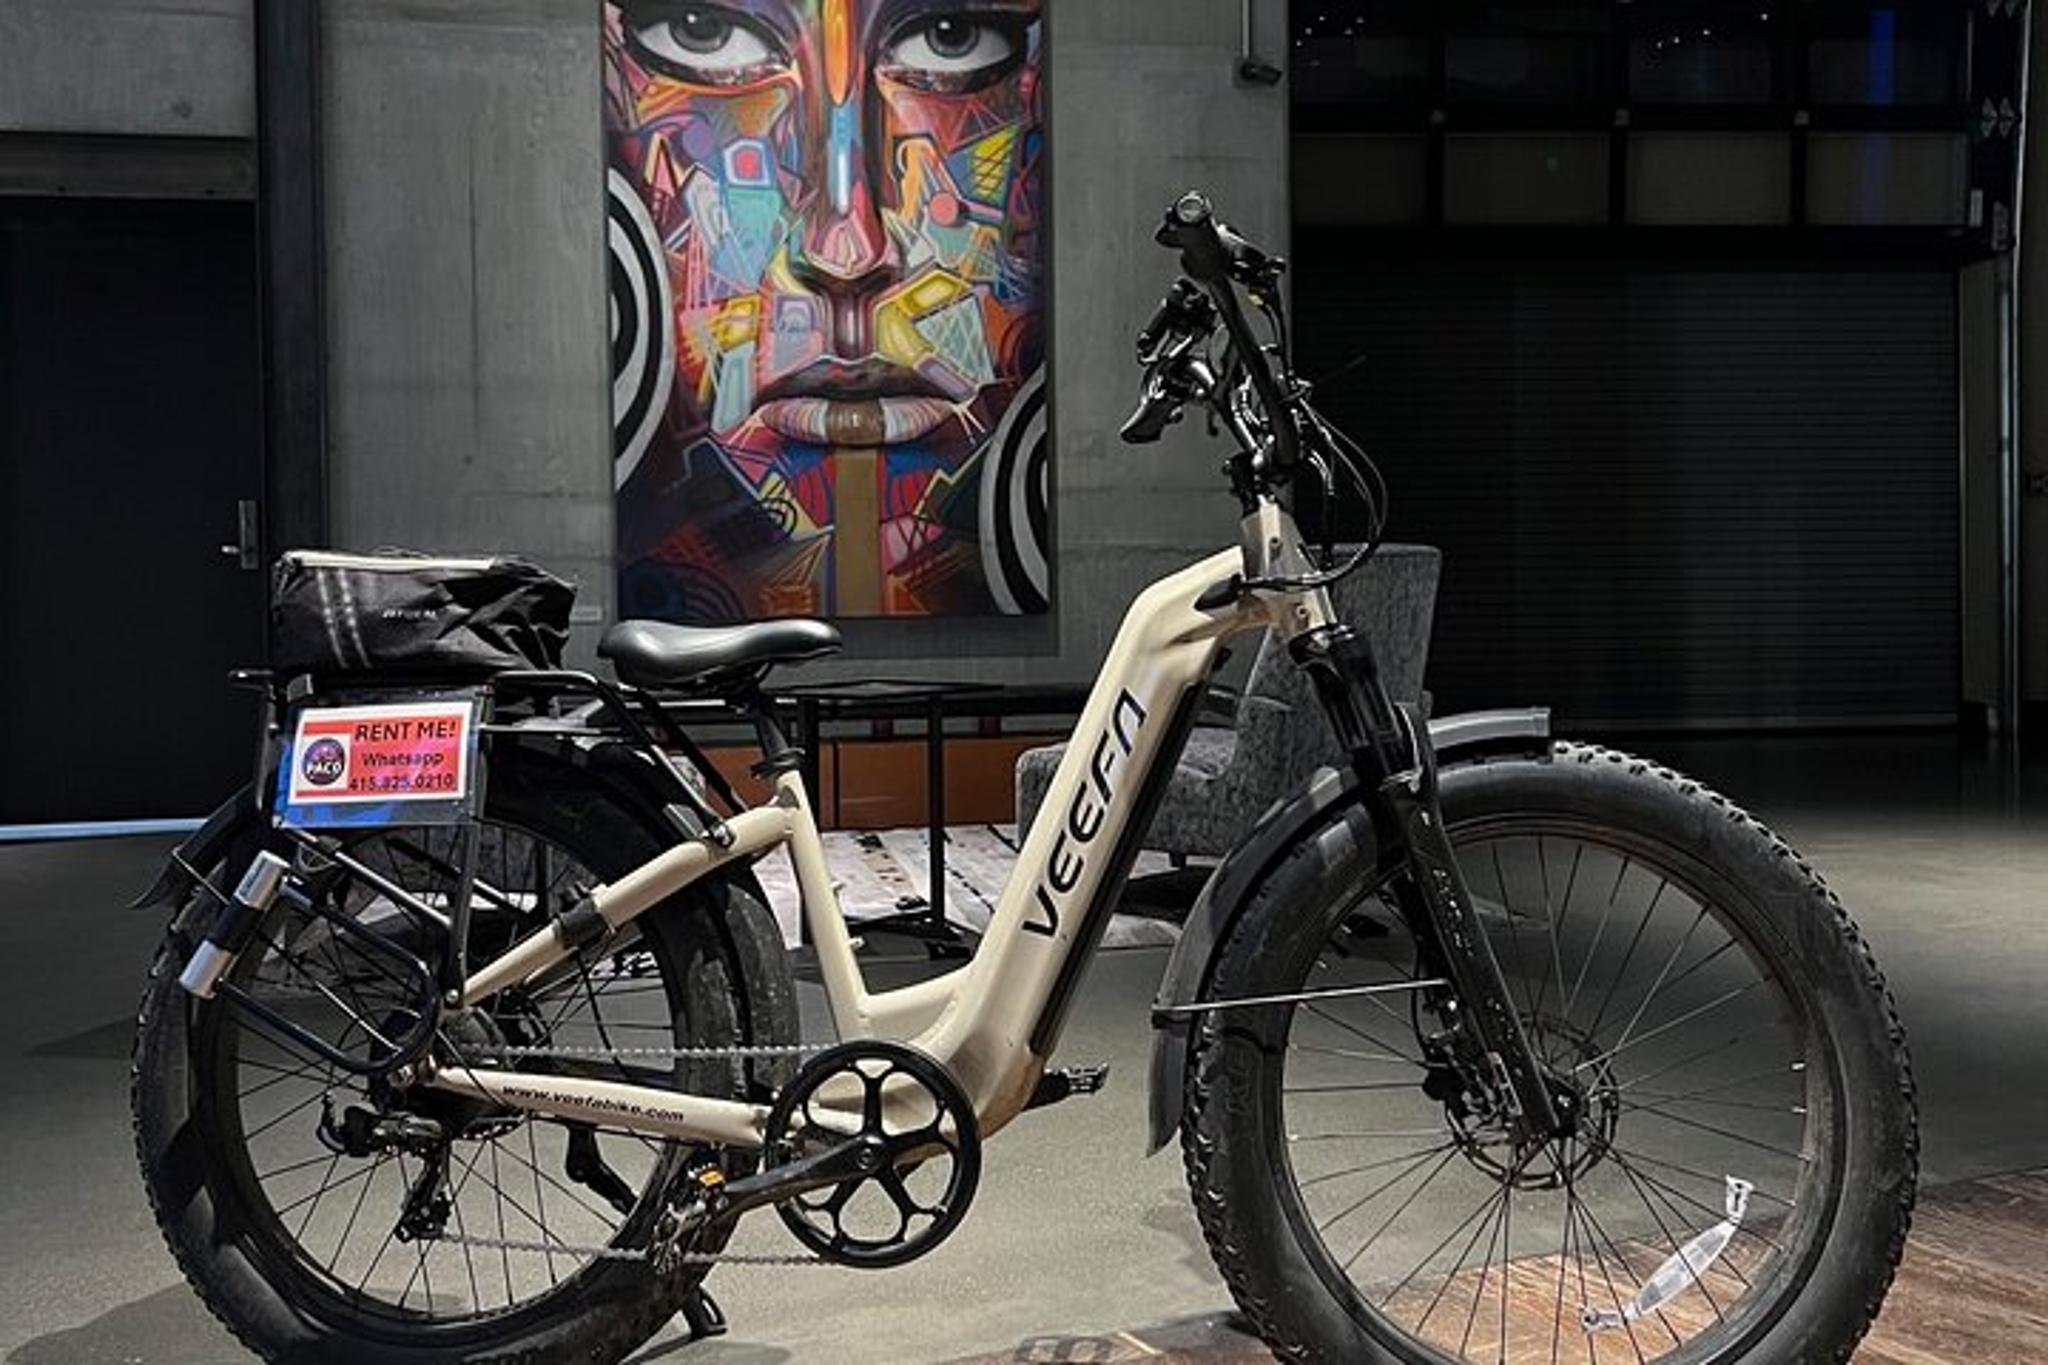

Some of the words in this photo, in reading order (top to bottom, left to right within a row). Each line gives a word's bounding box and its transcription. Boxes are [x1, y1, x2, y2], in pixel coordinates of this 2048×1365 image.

[355, 722, 411, 741] RENT
[417, 720, 456, 738] ME!
[1021, 687, 1147, 937] VEEFA
[501, 1085, 684, 1122] www.veefabike.com
